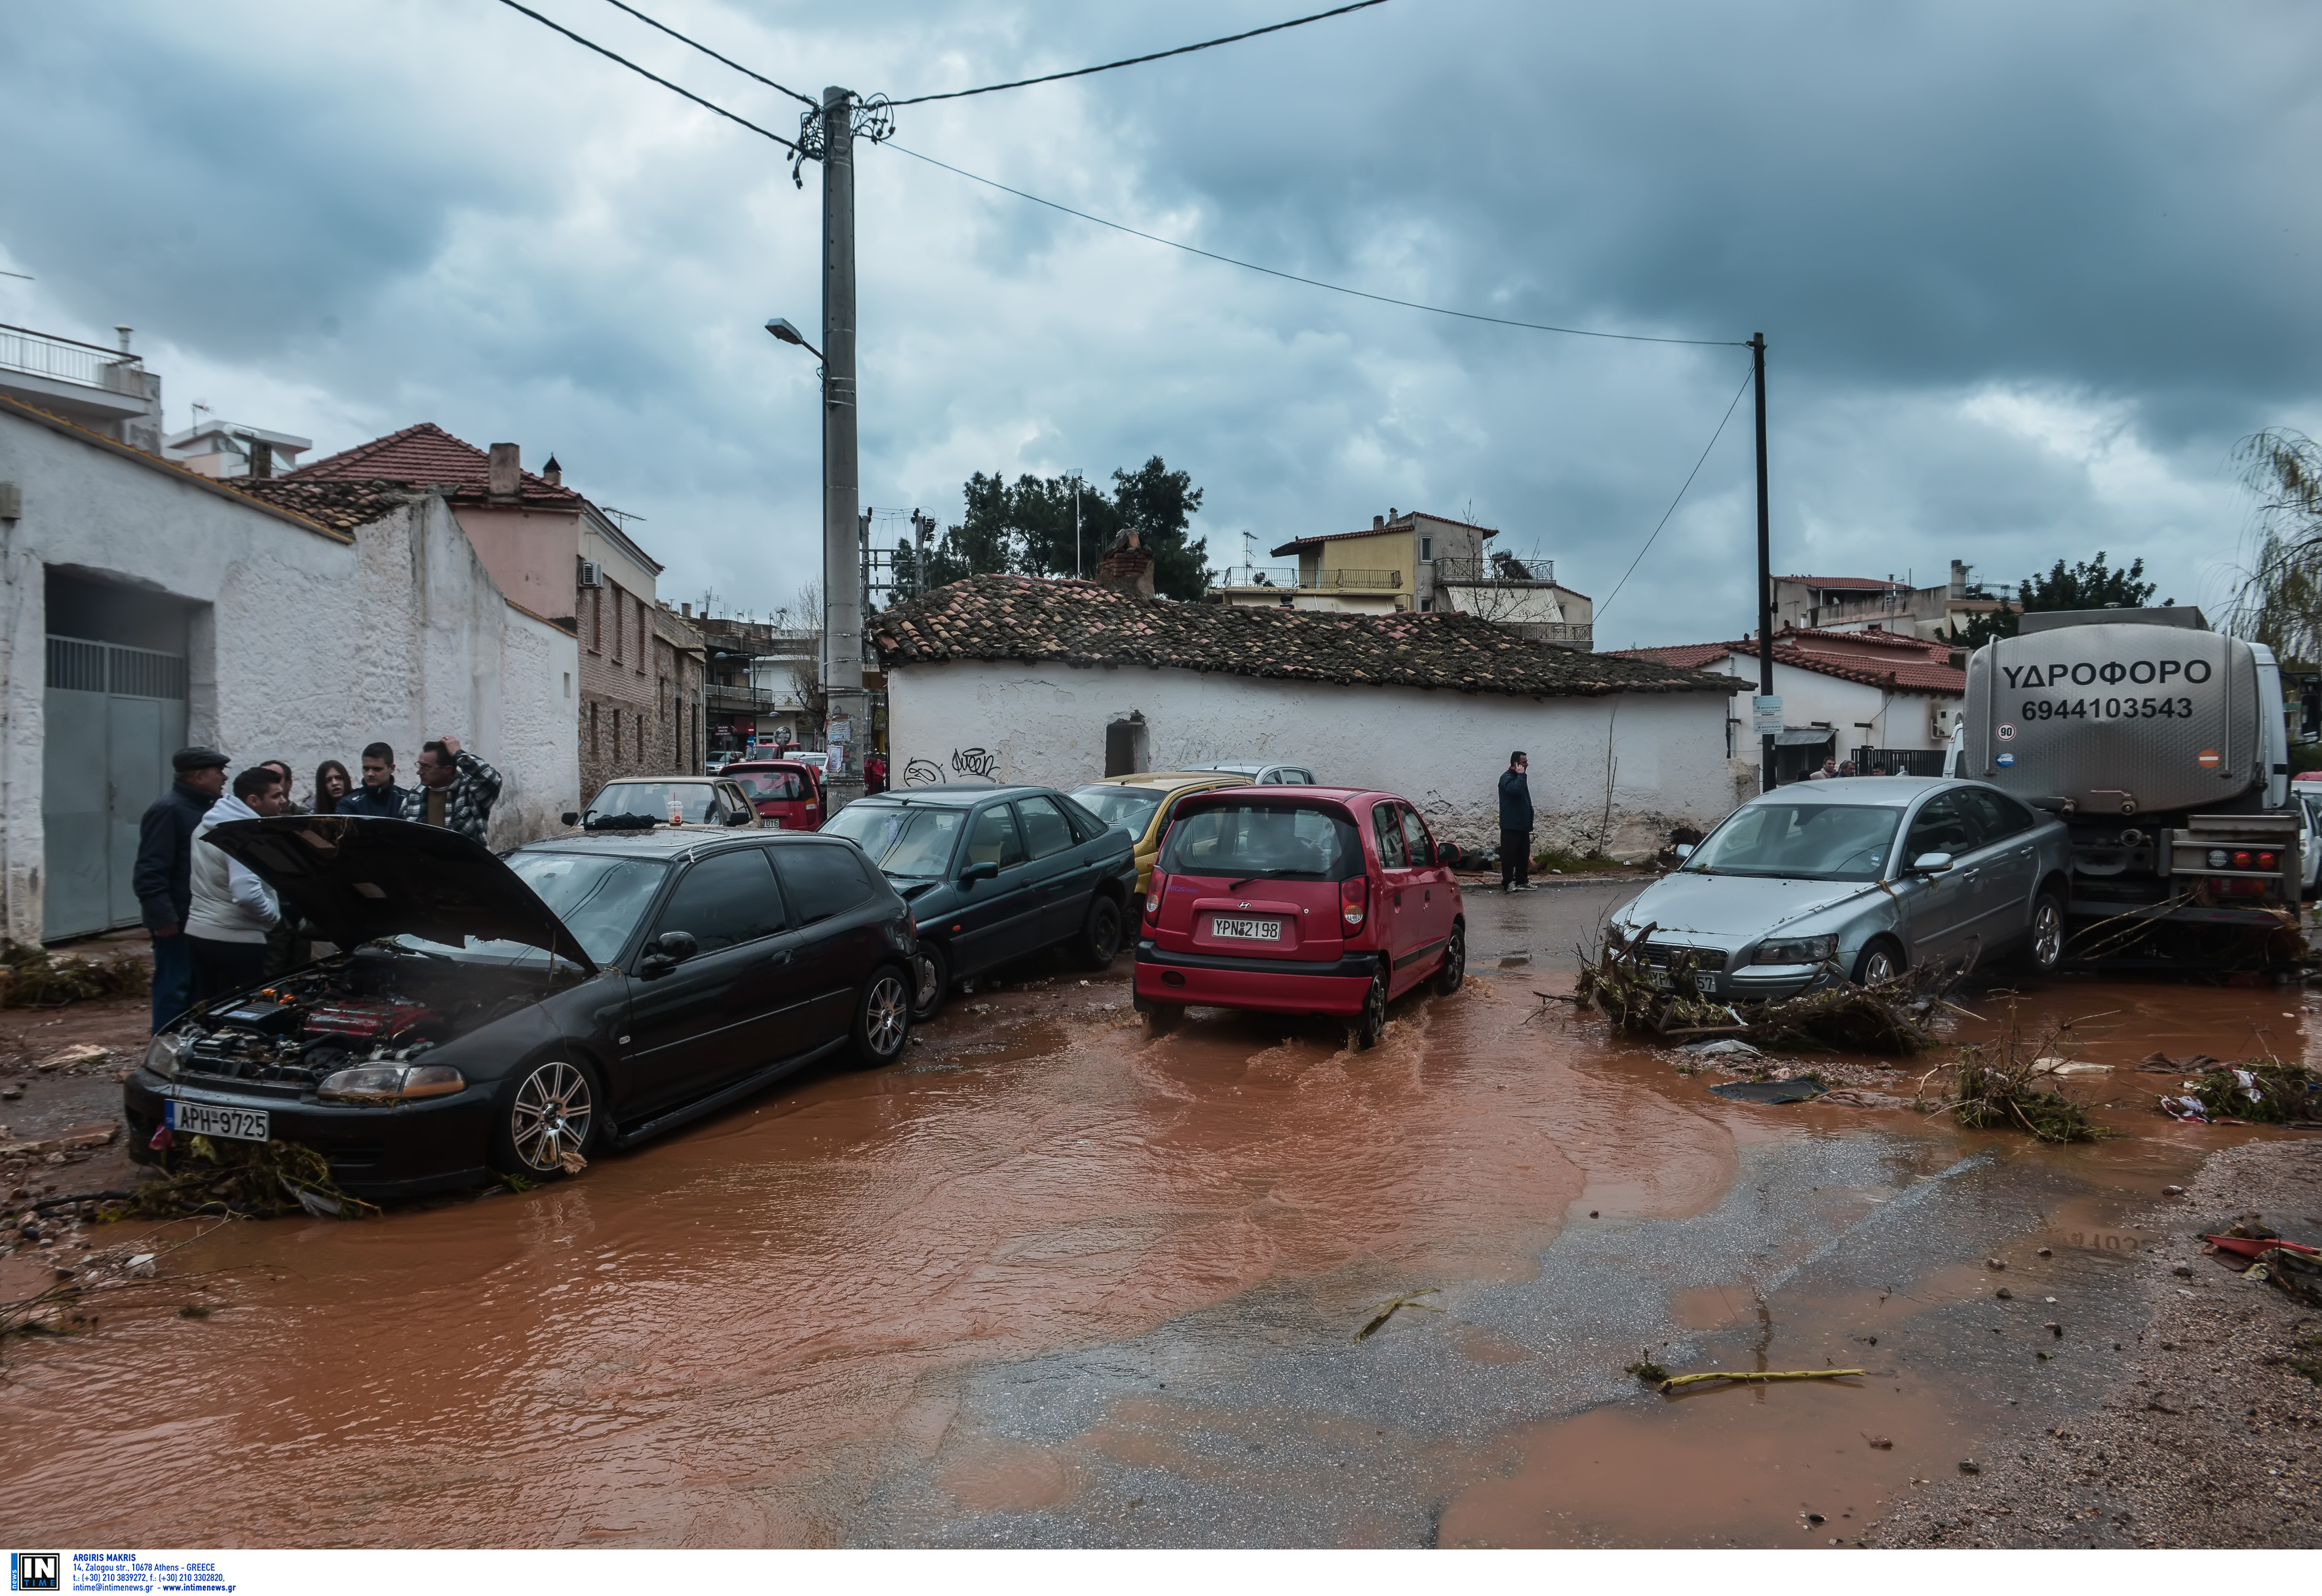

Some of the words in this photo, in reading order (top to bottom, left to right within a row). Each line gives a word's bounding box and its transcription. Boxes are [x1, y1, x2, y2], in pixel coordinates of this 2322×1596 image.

[2002, 660, 2211, 689] ΥΔΡΟΦΟΡΟ
[2022, 698, 2193, 721] 6944103543
[2001, 727, 2013, 736] 90
